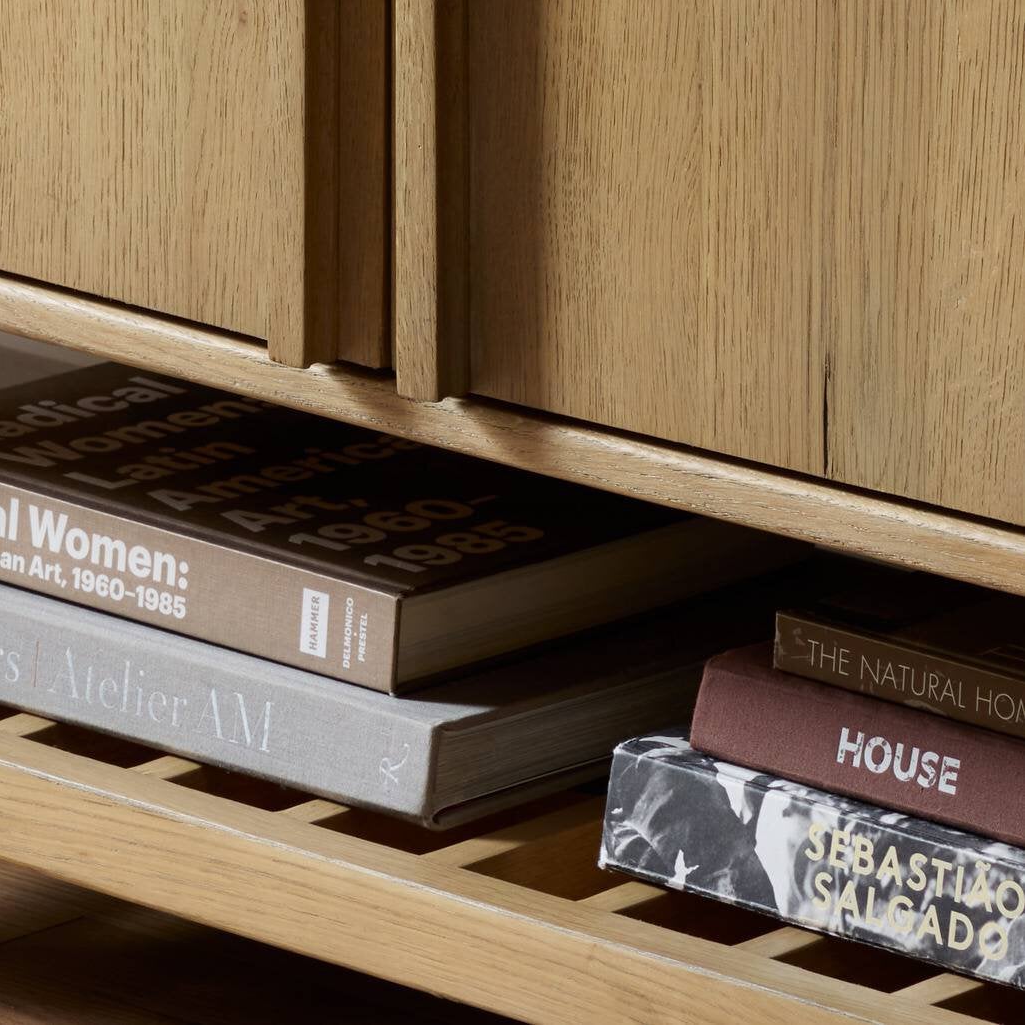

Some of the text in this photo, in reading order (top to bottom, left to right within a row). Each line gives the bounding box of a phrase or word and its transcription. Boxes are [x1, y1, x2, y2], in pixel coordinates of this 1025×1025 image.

[64, 439, 255, 490] Latin
[28, 504, 190, 591] Women:
[219, 495, 371, 534] Art,
[363, 519, 545, 574] 1985
[28, 554, 67, 589] Art,
[309, 595, 321, 652] HAMMER
[342, 596, 354, 670] DELMONICO
[357, 612, 368, 663] PRESTEL
[47, 645, 189, 730] Atelier
[196, 687, 276, 754] AM
[807, 639, 851, 677] THE
[860, 654, 967, 710] NATURAL
[836, 726, 961, 796] HOUSE
[804, 821, 1025, 920] SEBASTIÃO
[812, 870, 1009, 962] SALGADO
